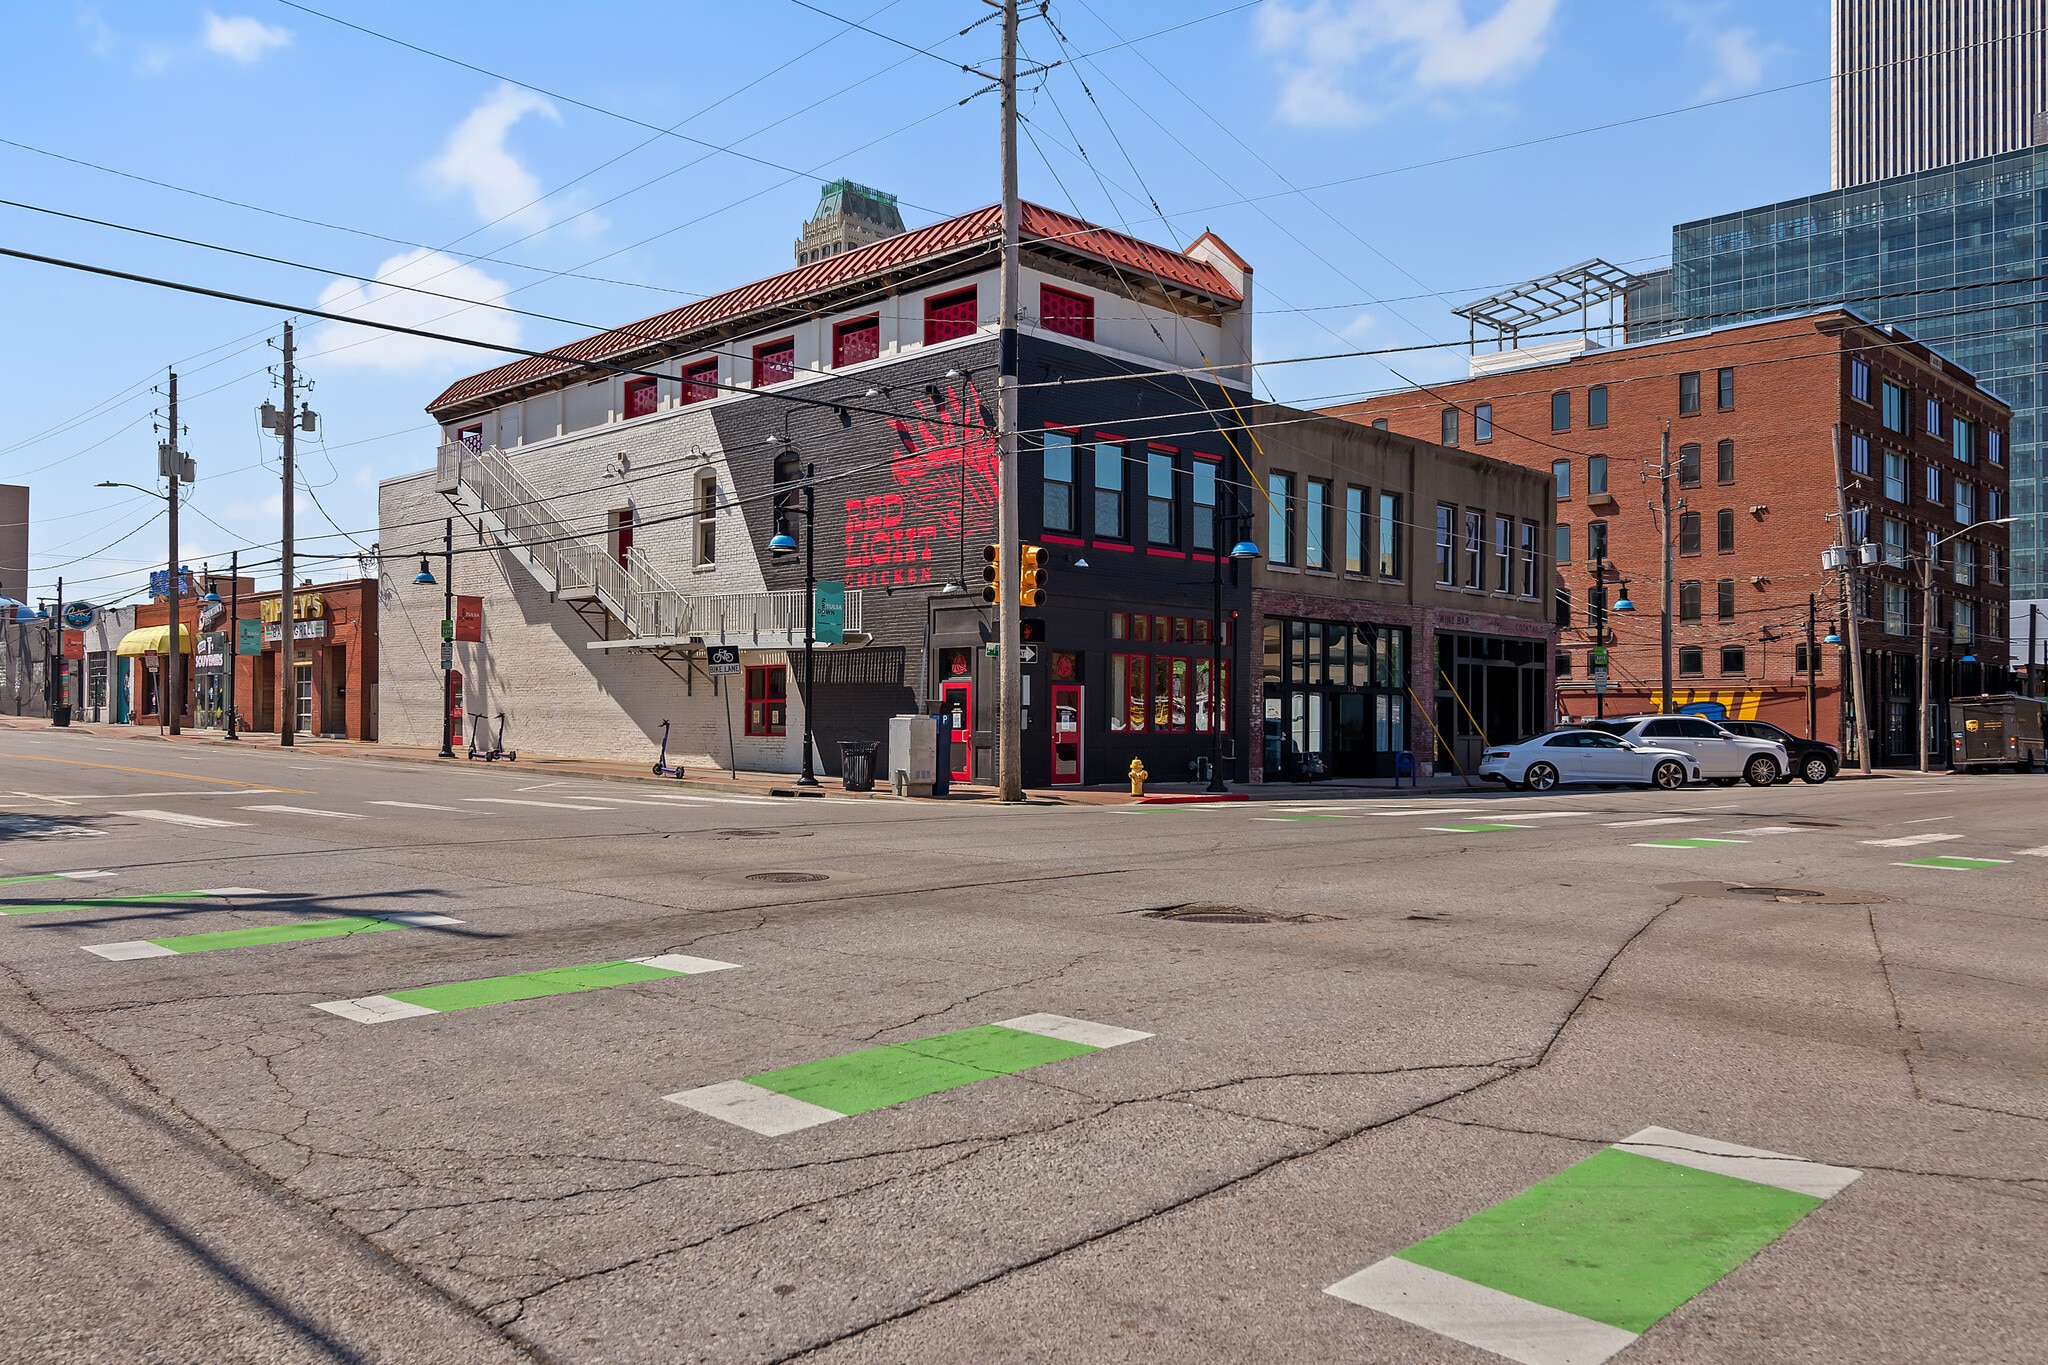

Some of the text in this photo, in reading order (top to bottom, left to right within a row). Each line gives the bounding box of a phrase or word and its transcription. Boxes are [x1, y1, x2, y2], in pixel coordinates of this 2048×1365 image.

[845, 494, 904, 532] RED
[845, 566, 931, 588] CHICKEN
[260, 592, 323, 622] RIPEY'S
[294, 623, 314, 636] GRILL
[710, 664, 740, 673] BIKE LANE
[943, 715, 947, 724] P
